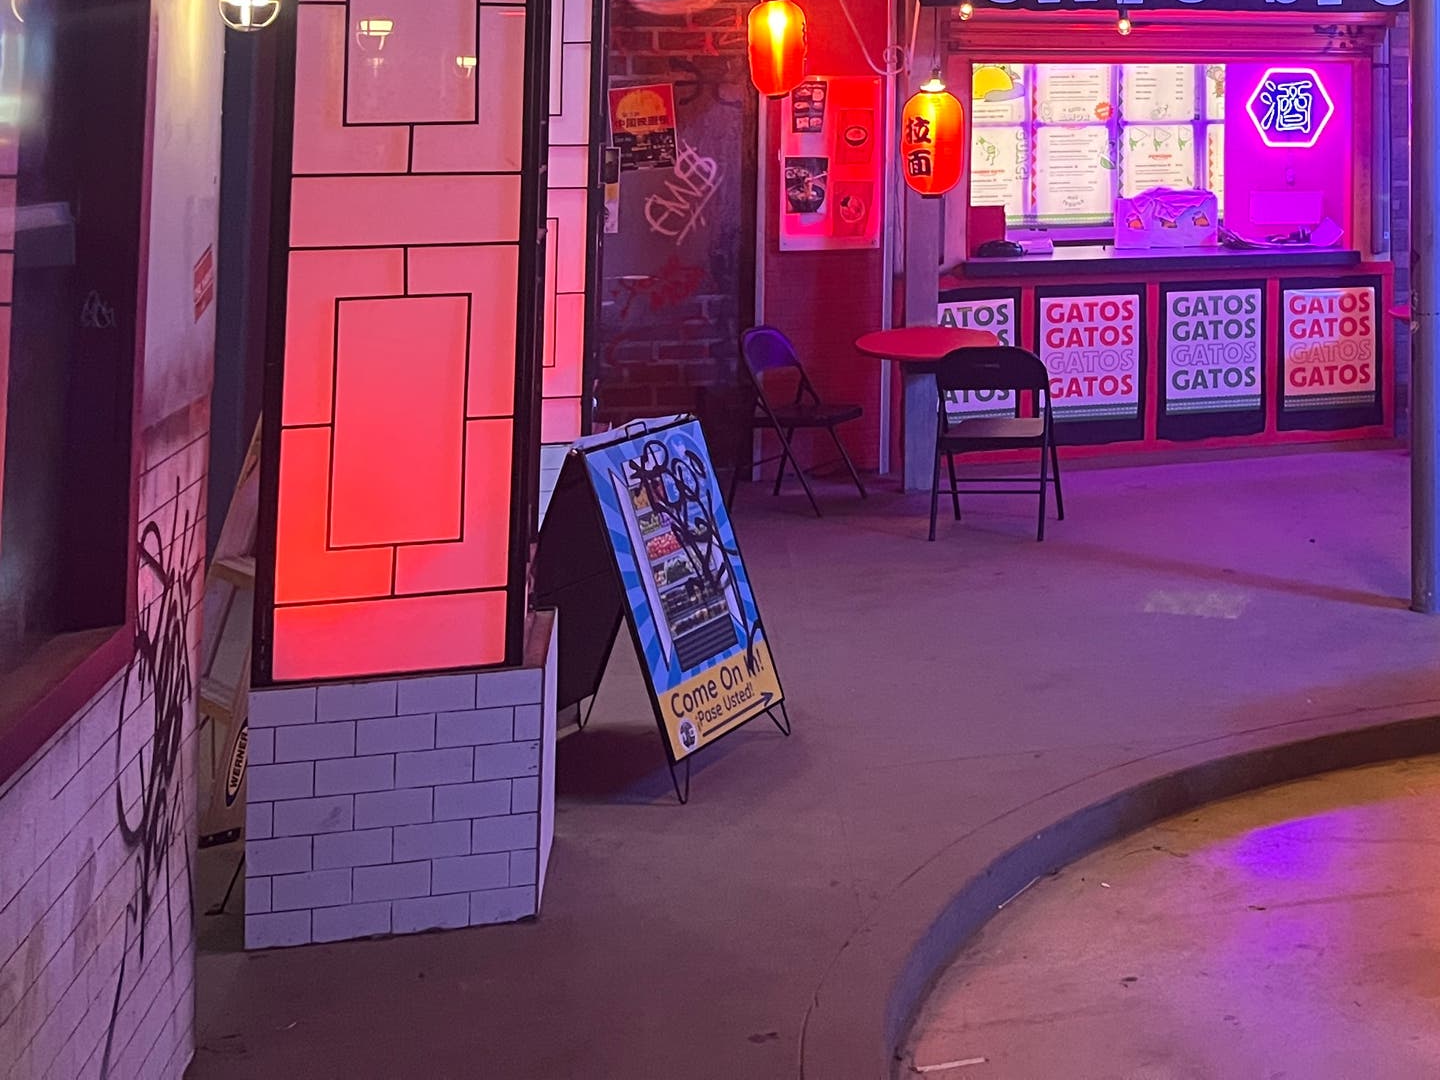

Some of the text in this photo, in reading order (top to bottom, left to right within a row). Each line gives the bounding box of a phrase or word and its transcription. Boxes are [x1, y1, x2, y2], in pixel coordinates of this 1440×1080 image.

[1260, 80, 1313, 133] 酒
[905, 115, 931, 177] 拉面
[1045, 300, 1135, 325] GATOS
[1172, 294, 1257, 318] GATOS
[1288, 291, 1371, 316] GATOS
[1045, 324, 1135, 350] GATOS
[1172, 317, 1257, 342] GATOS
[1288, 315, 1371, 340] GATOS
[1046, 349, 1135, 375] GATOS
[1171, 341, 1257, 367] GATOS
[1288, 339, 1371, 364] GATOS
[1049, 374, 1134, 400] GATOS
[1172, 366, 1257, 392] GATOS
[1288, 363, 1371, 389] GATOS
[671, 680, 718, 718] Come
[720, 665, 743, 690] On
[722, 682, 756, 711] Usted!
[230, 731, 248, 788] WERNER
